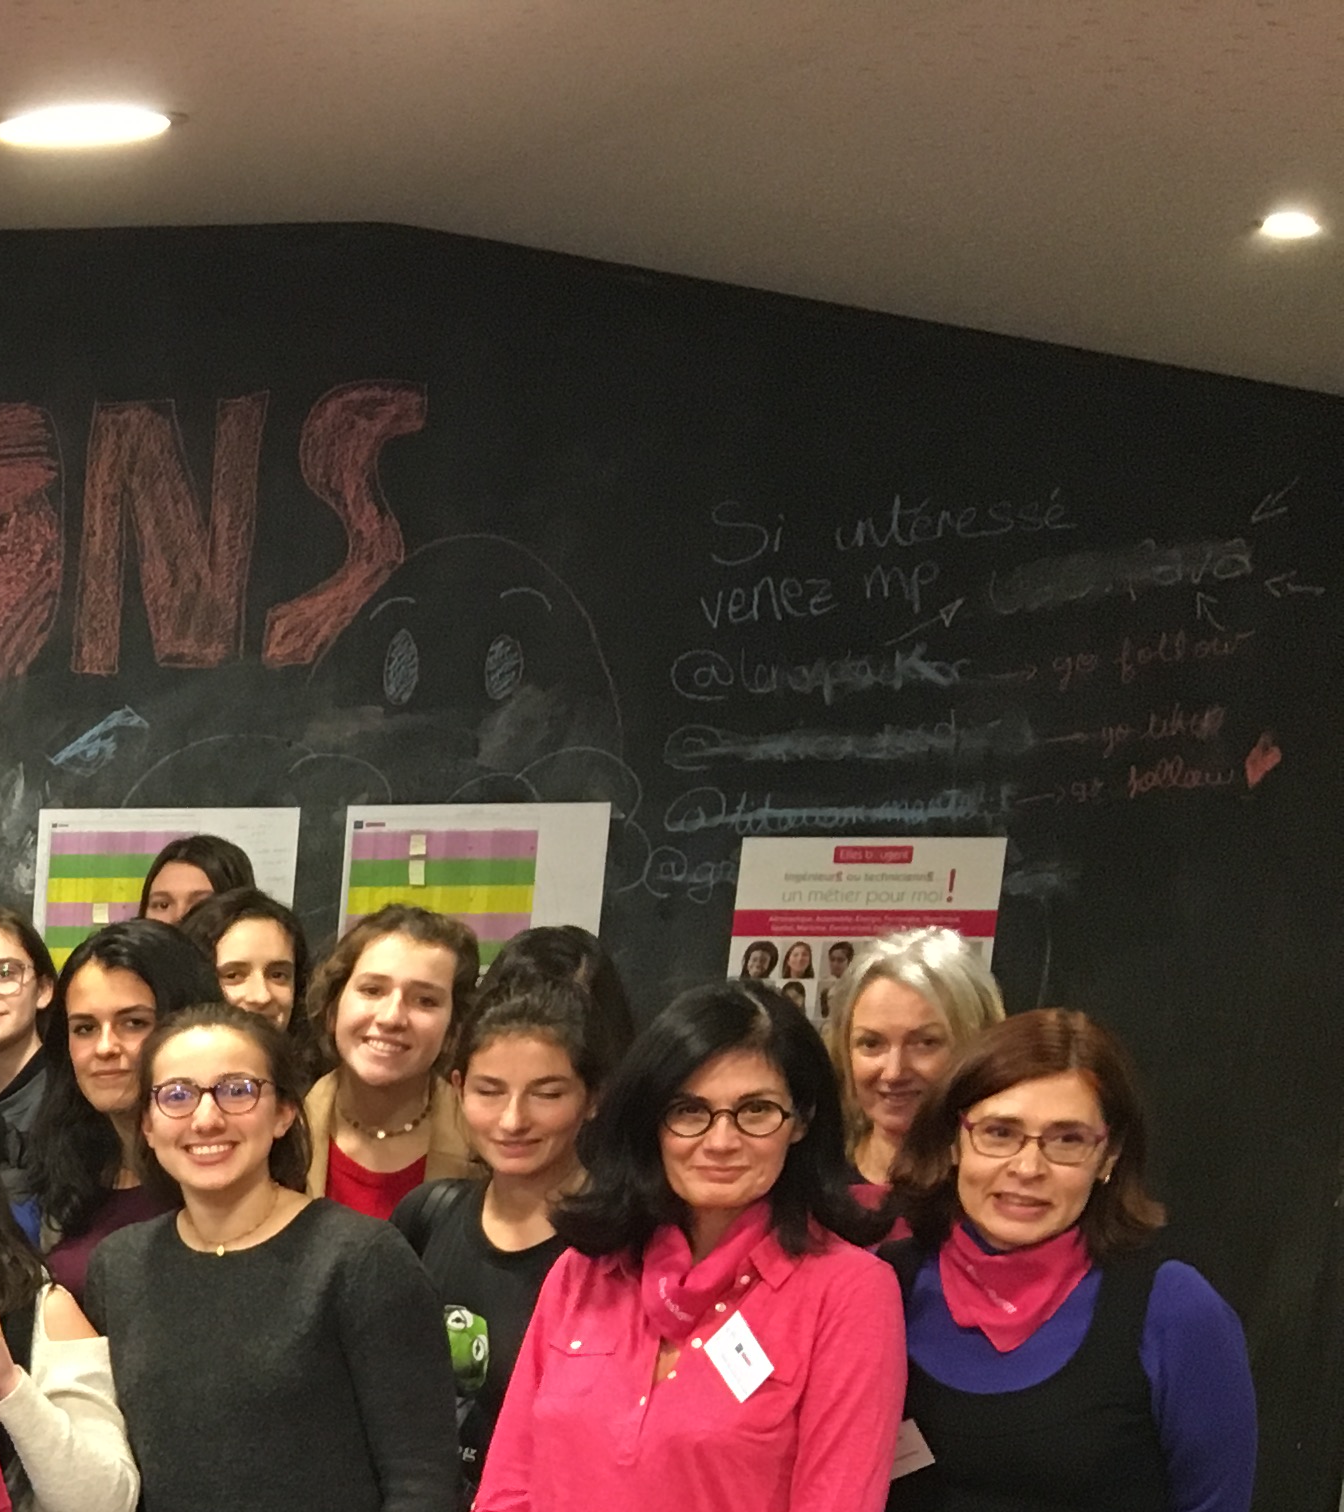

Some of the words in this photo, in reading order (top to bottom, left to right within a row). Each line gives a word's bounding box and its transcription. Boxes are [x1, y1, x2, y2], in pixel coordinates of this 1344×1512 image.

[711, 501, 785, 566] Si
[700, 575, 839, 630] venez
[782, 890, 803, 903] un
[865, 890, 905, 906] pour
